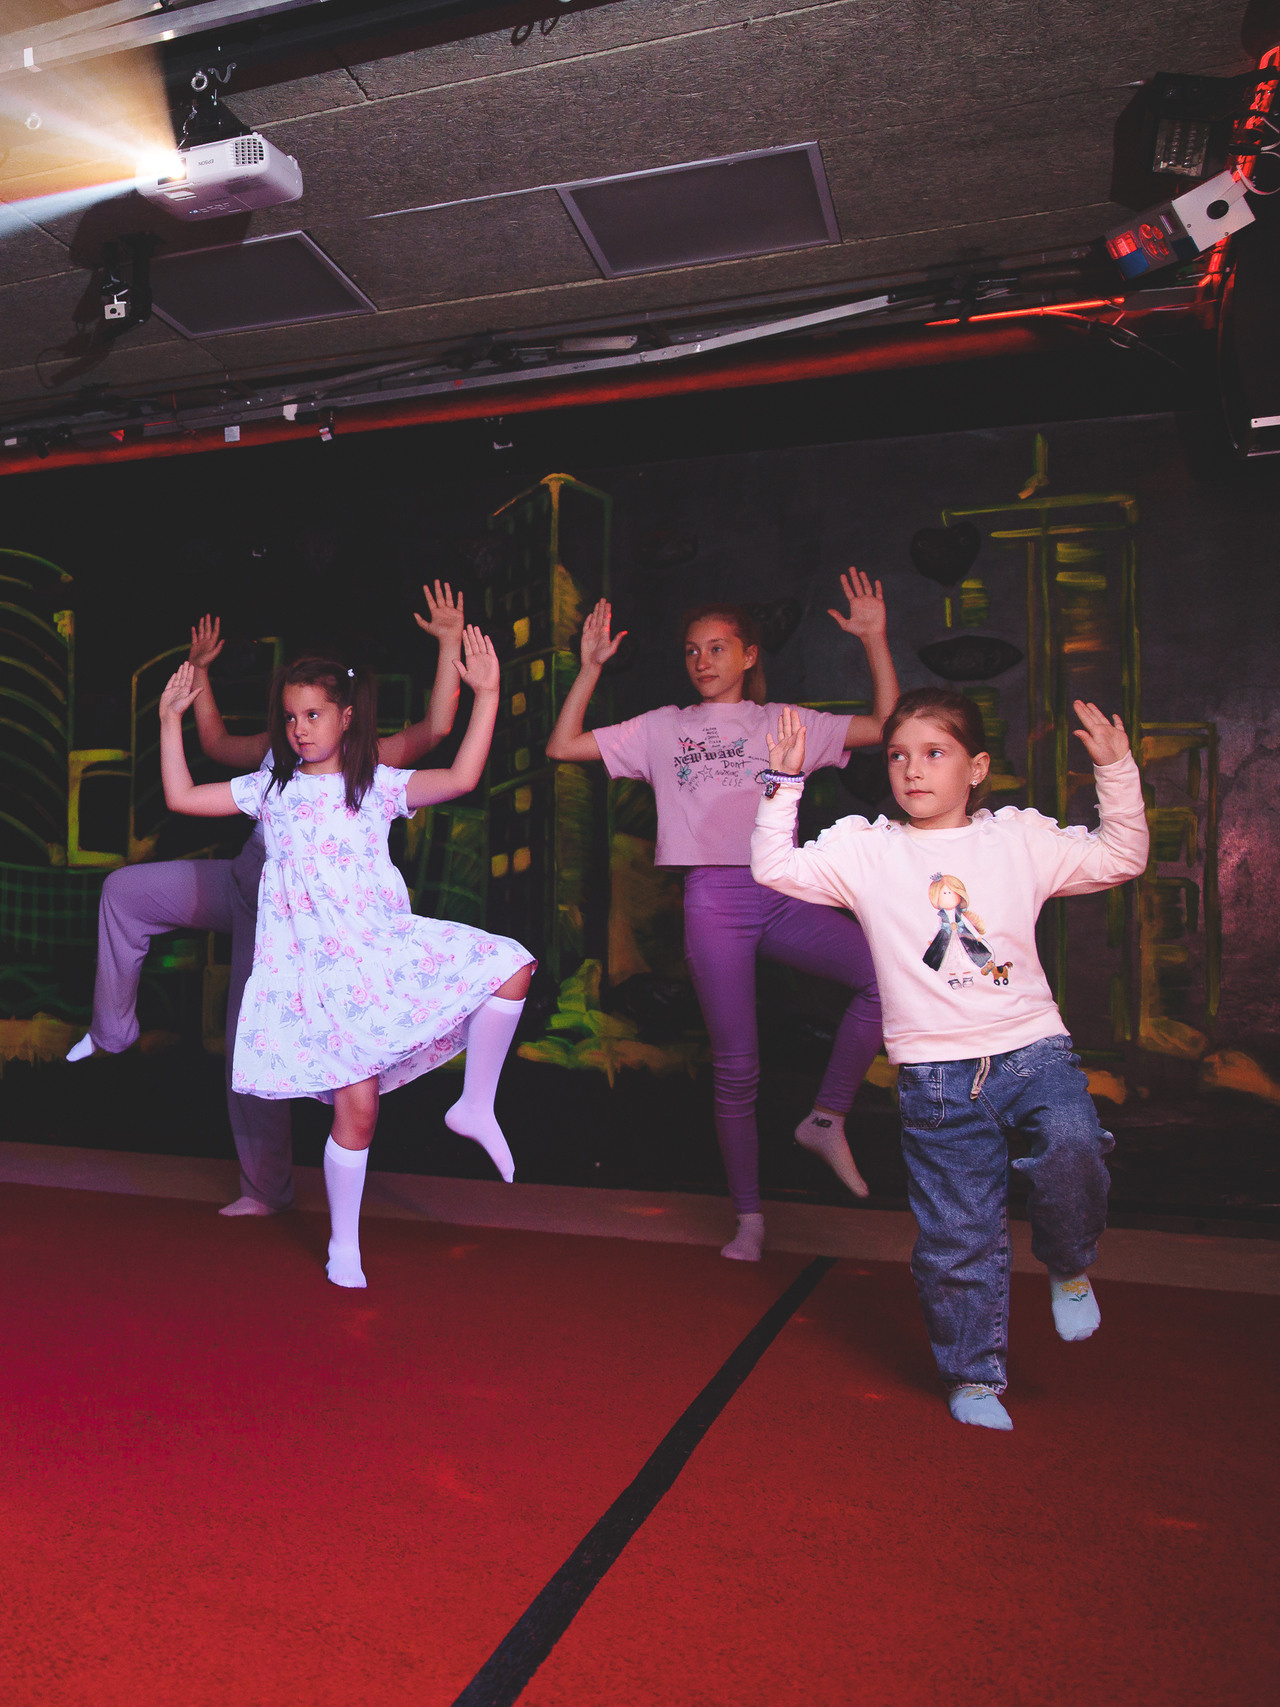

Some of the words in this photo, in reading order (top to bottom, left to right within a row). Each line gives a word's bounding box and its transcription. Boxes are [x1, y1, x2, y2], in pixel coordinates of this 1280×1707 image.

[674, 753, 703, 767] NEW
[704, 747, 745, 761] WAVE
[721, 777, 743, 788] ELSE
